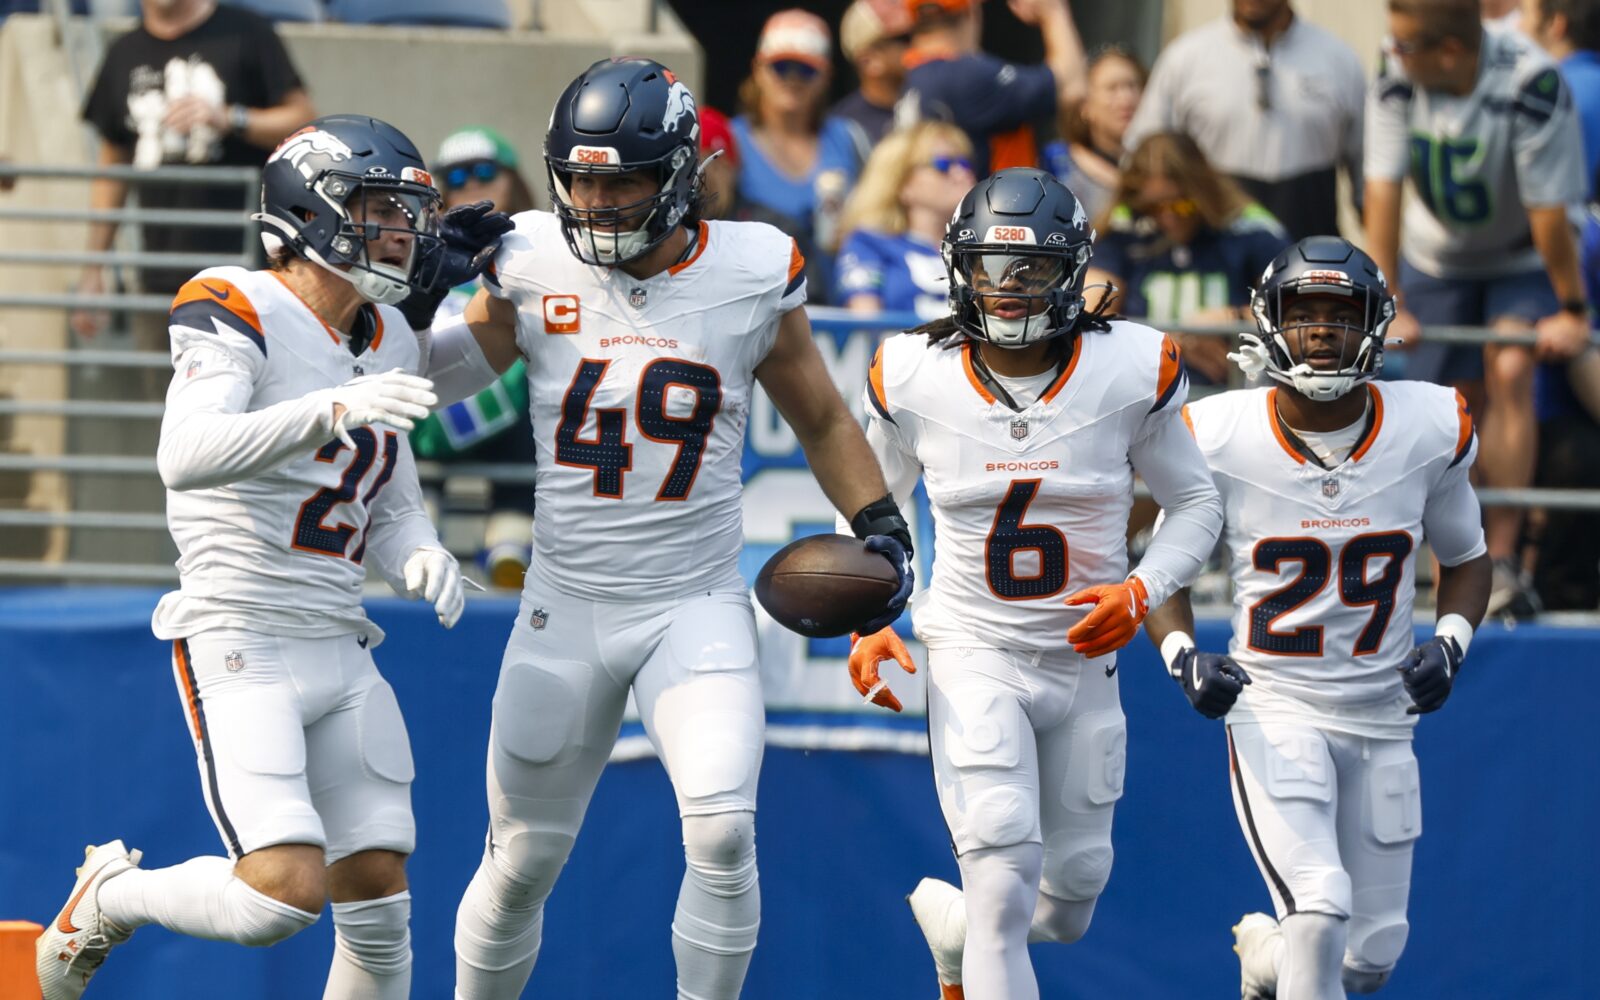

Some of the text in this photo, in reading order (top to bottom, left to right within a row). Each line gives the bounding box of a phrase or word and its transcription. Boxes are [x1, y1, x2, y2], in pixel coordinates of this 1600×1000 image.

[577, 149, 608, 163] 5280
[994, 228, 1026, 241] 5280
[545, 297, 577, 324] C
[600, 336, 679, 349] BRONCOS
[554, 357, 722, 501] 49
[985, 460, 1059, 472] BRONCOS
[290, 424, 399, 565] 21
[1301, 518, 1370, 529] BRONCOS
[985, 478, 1069, 601] 6
[1247, 529, 1413, 657] 29
